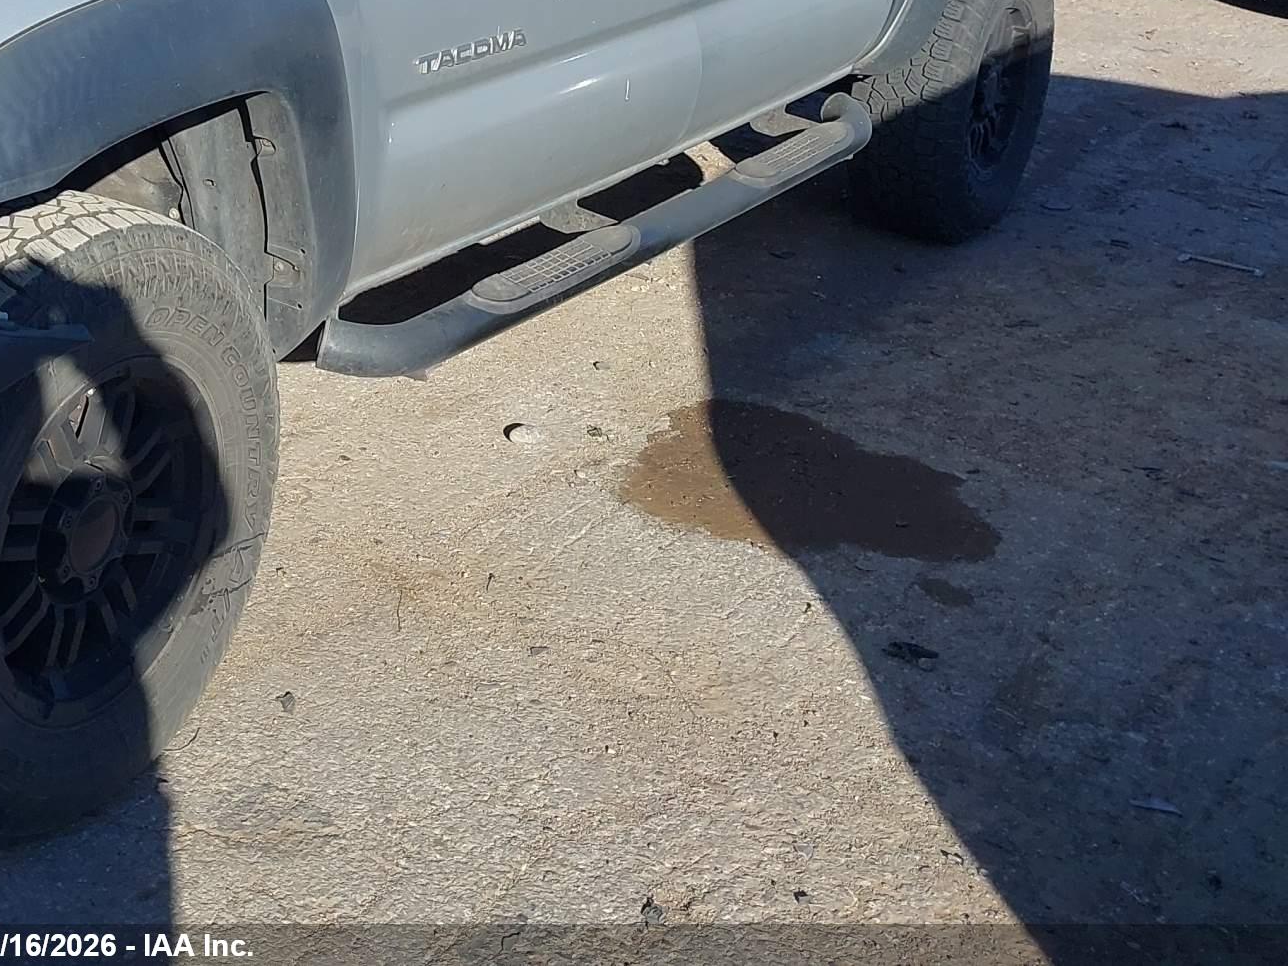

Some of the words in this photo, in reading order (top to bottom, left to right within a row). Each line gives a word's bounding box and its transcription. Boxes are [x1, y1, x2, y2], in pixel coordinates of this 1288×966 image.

[413, 27, 527, 74] TACOMA
[143, 300, 225, 347] OPEN
[220, 345, 263, 531] COUNTRY
